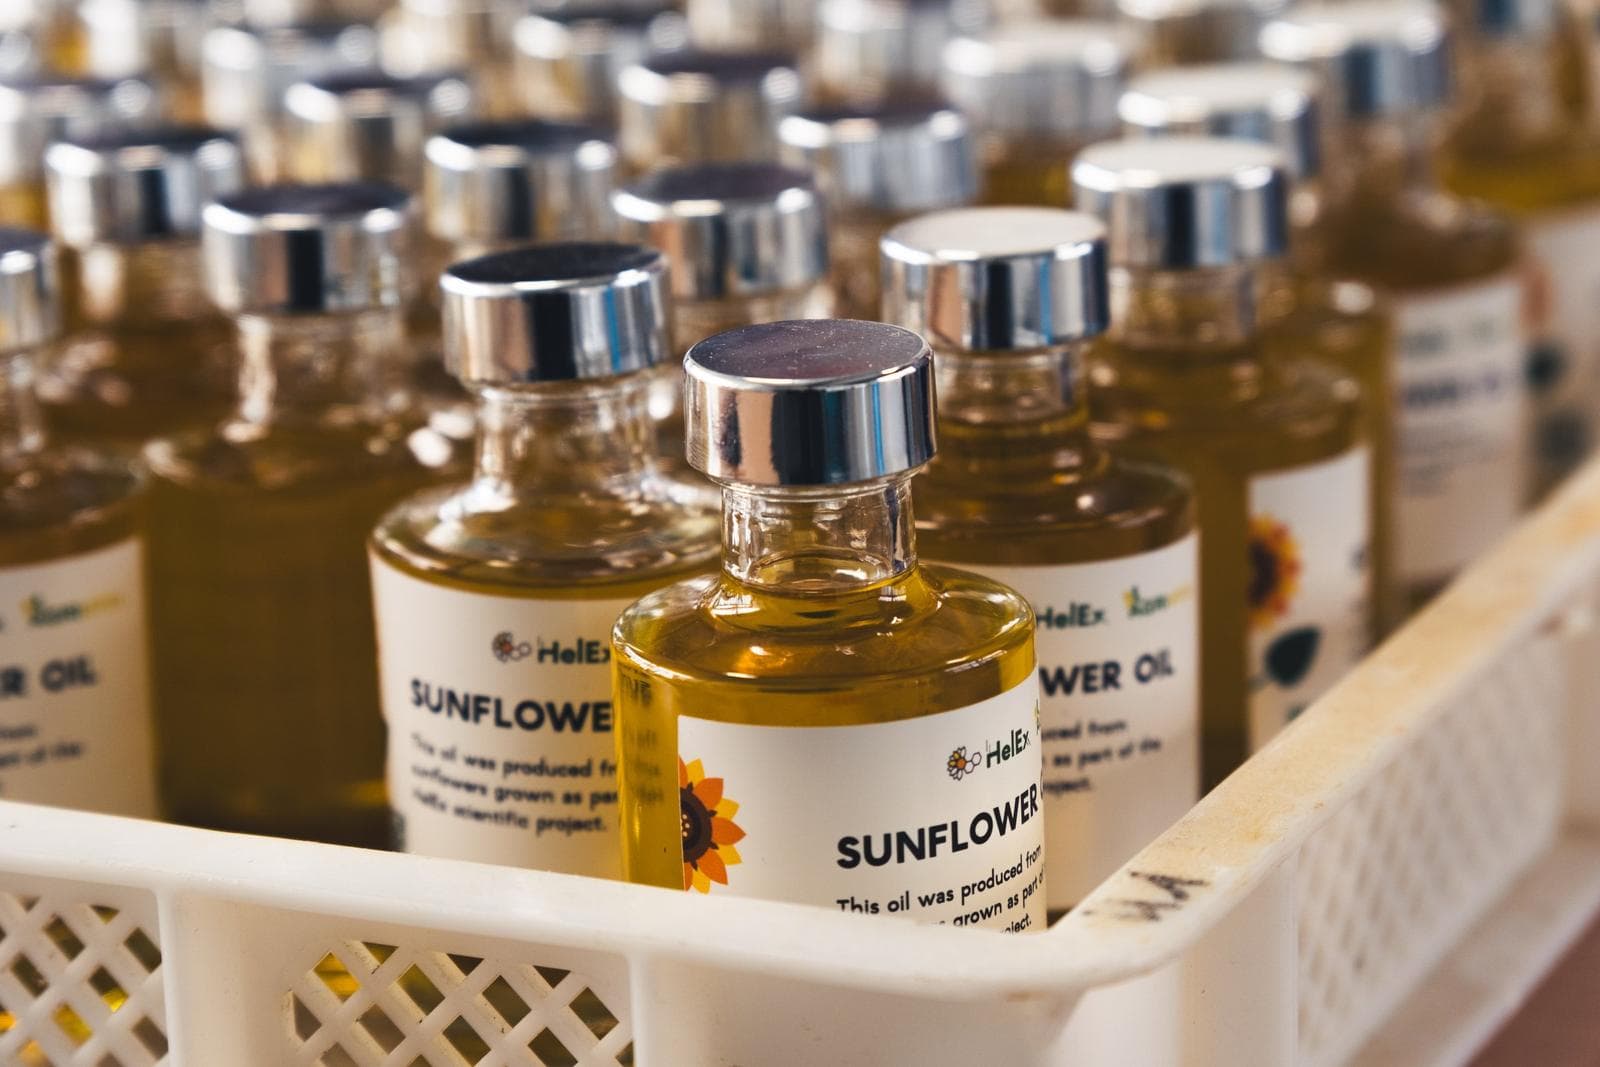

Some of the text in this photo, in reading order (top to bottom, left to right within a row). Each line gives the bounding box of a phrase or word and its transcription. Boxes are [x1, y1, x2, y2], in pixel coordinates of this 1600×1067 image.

[40, 653, 97, 692] OIL
[1134, 648, 1174, 684] OIL
[411, 678, 612, 733] SUNFLOWE
[464, 754, 496, 771] was
[503, 758, 592, 780] produced
[599, 758, 617, 777] fr
[986, 728, 1031, 769] HelEx
[495, 784, 554, 805] grown
[562, 789, 582, 805] as
[590, 789, 618, 809] par
[454, 805, 529, 829] scientific
[536, 816, 606, 837] project.
[837, 783, 1039, 869] SUNFLOWER
[837, 844, 1042, 914] This oil was produced from
[1007, 893, 1019, 909] as
[1022, 876, 1038, 909] part
